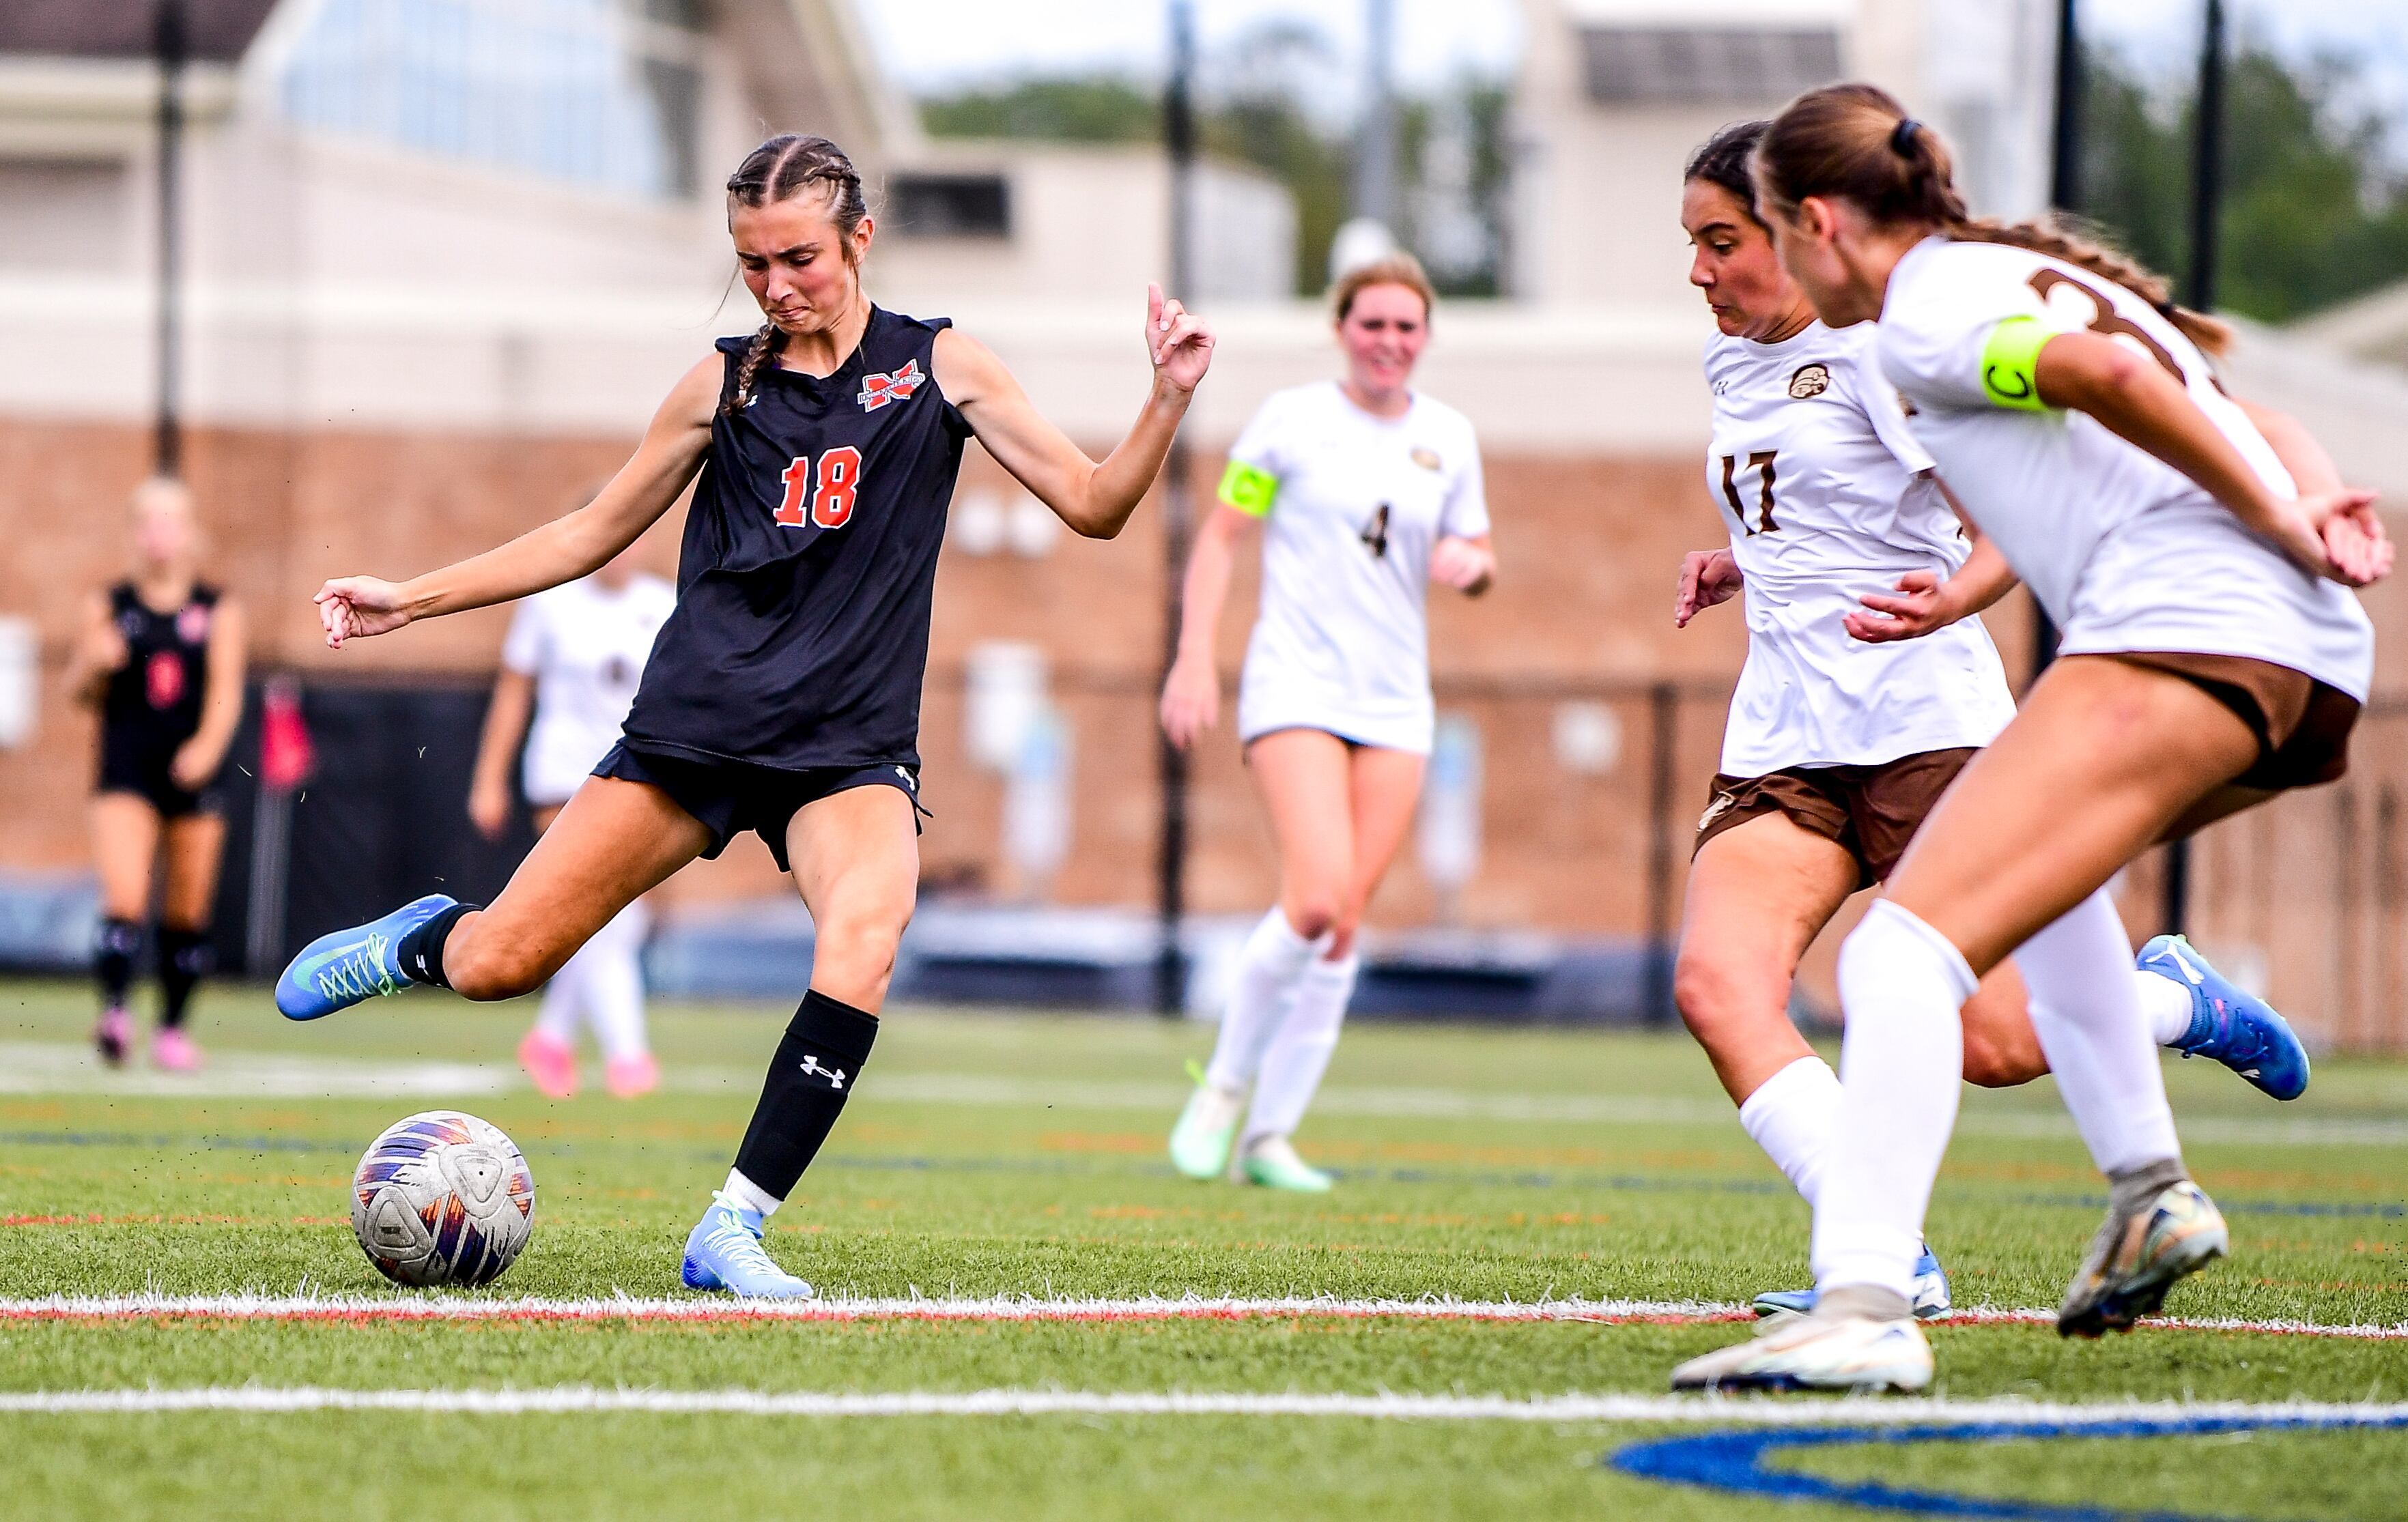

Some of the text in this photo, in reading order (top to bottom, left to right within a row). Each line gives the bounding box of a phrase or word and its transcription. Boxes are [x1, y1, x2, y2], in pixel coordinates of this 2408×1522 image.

[1987, 365, 2028, 398] C
[773, 446, 862, 529] 18
[1719, 448, 1781, 537] 17
[1361, 504, 1389, 557] 4
